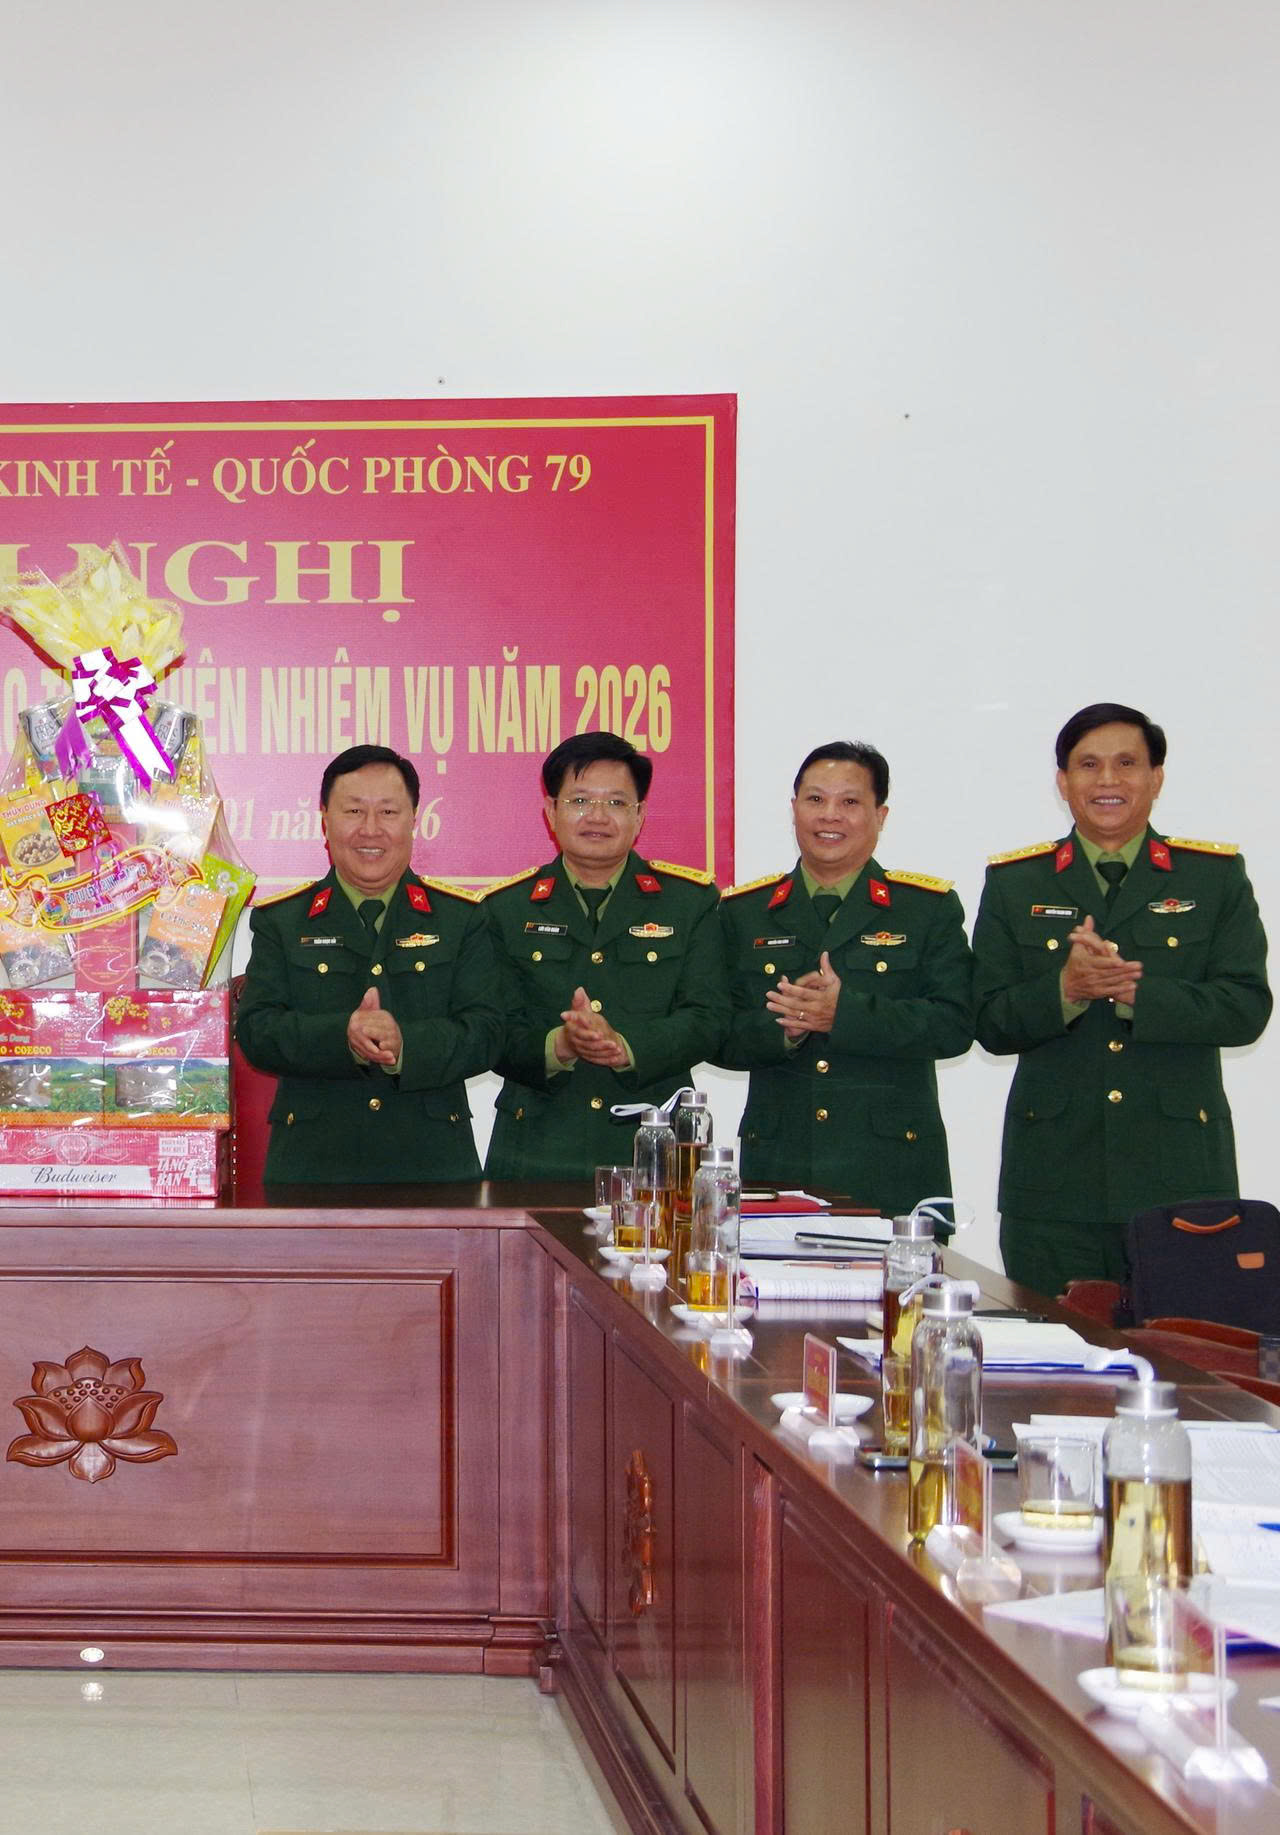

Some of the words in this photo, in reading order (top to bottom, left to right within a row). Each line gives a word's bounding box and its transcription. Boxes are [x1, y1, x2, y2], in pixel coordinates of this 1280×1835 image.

[113, 439, 175, 496] TẾ
[212, 438, 350, 504] QUỐC
[362, 443, 533, 494] PHÒNG
[545, 454, 592, 492] 79
[403, 666, 455, 775] VỤ
[468, 646, 561, 753] NĂM
[575, 664, 672, 753] 2026
[30, 1166, 117, 1184] Budweiser
